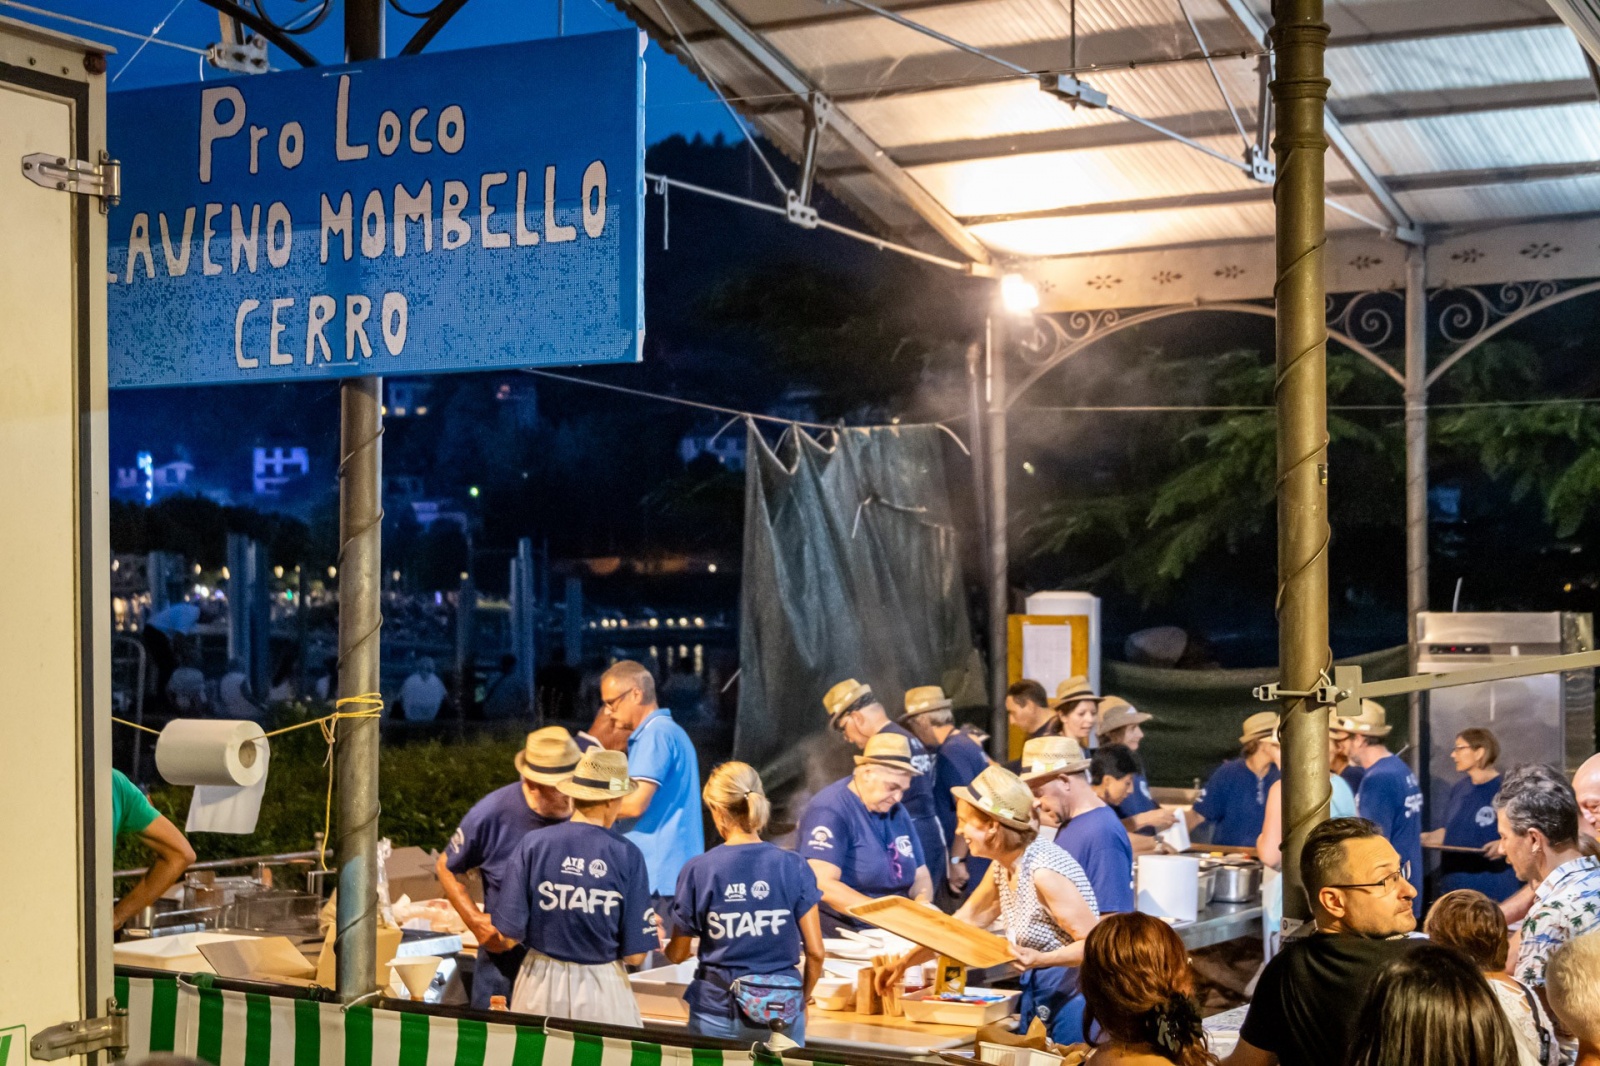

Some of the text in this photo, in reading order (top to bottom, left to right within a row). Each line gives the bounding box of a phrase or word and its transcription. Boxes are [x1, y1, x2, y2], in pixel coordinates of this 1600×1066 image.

[199, 74, 466, 183] Pro Loco
[107, 160, 608, 285] AVENO MOMBELLO
[235, 291, 408, 368] CERRO
[538, 881, 624, 916] STAFF
[706, 909, 791, 940] STAFF
